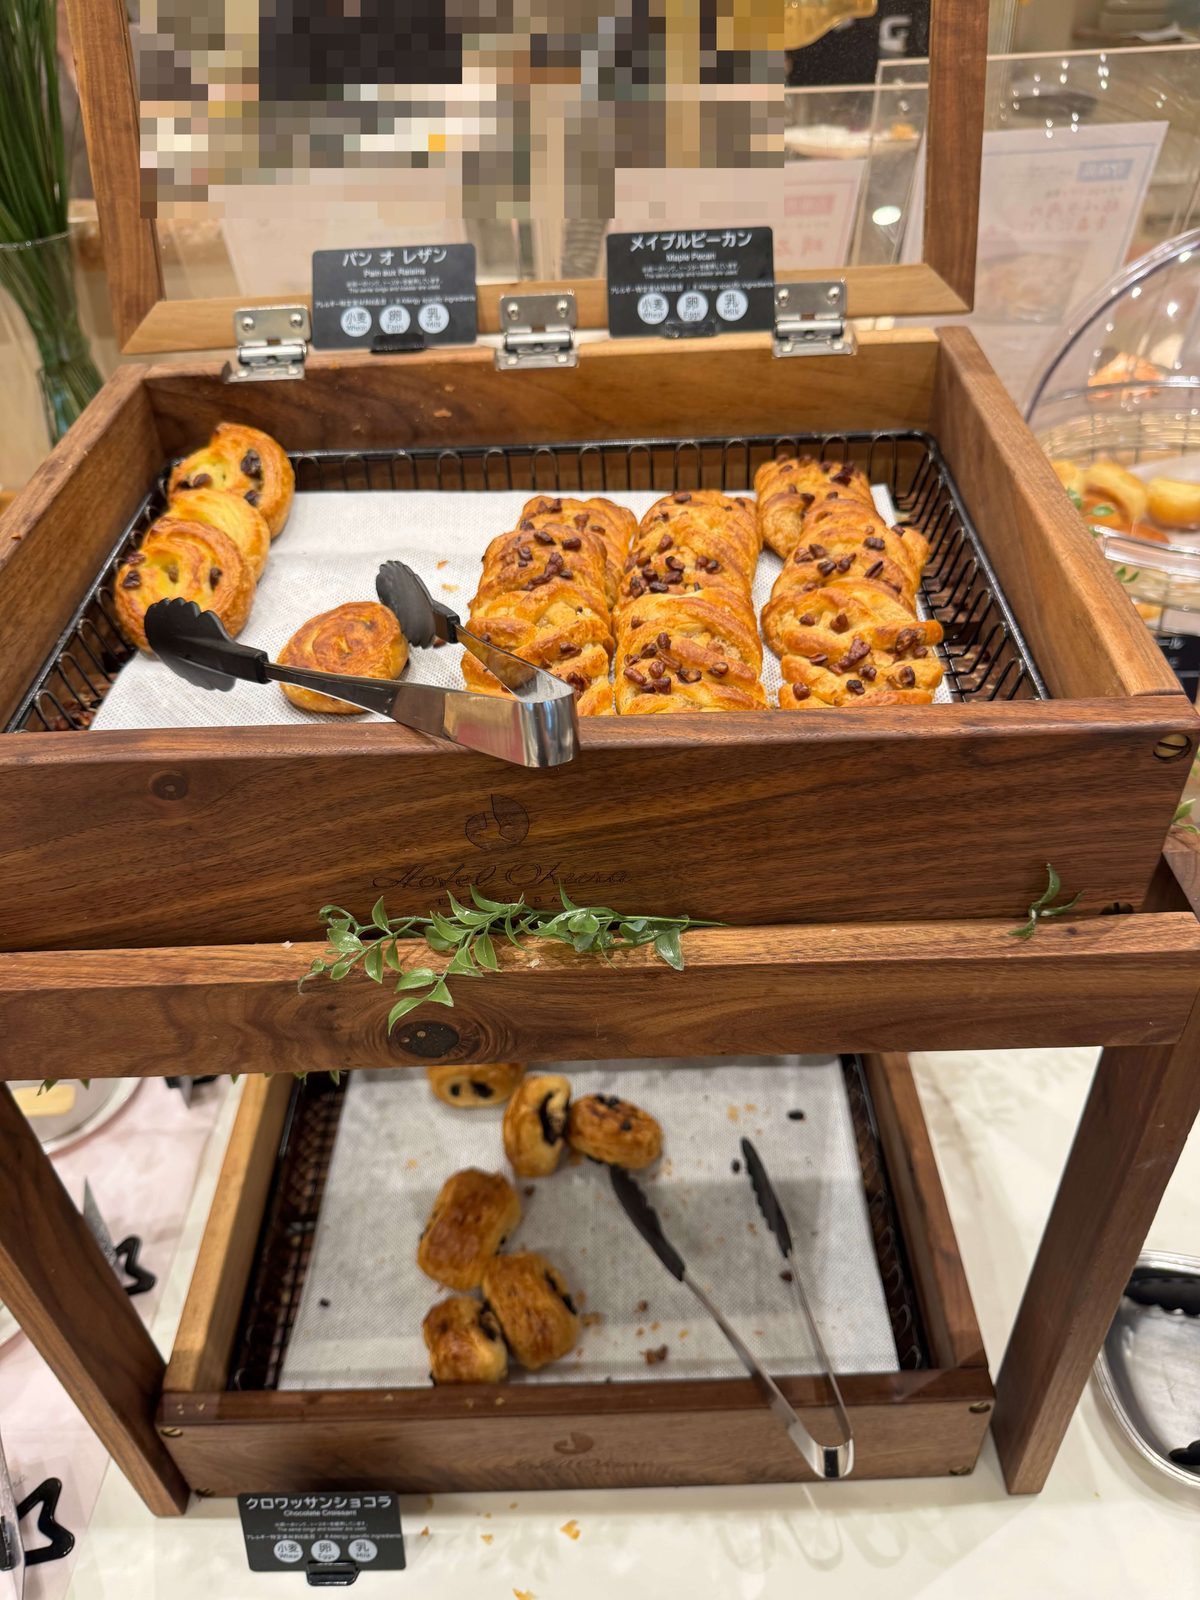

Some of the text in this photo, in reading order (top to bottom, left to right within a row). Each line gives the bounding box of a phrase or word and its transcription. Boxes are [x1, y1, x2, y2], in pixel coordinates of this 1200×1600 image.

[666, 251, 716, 263] Maple Pecan
[642, 298, 664, 311] 小麦
[685, 296, 699, 311] 卵
[725, 293, 739, 308] 乳
[345, 311, 367, 324] 小麦
[427, 307, 441, 321] 乳
[246, 1495, 392, 1510] クロワッサンショコラ
[283, 1509, 321, 1517] Chocolate
[277, 1543, 300, 1553] 小麦
[319, 1542, 332, 1553] 卵
[355, 1541, 370, 1552] 乳
